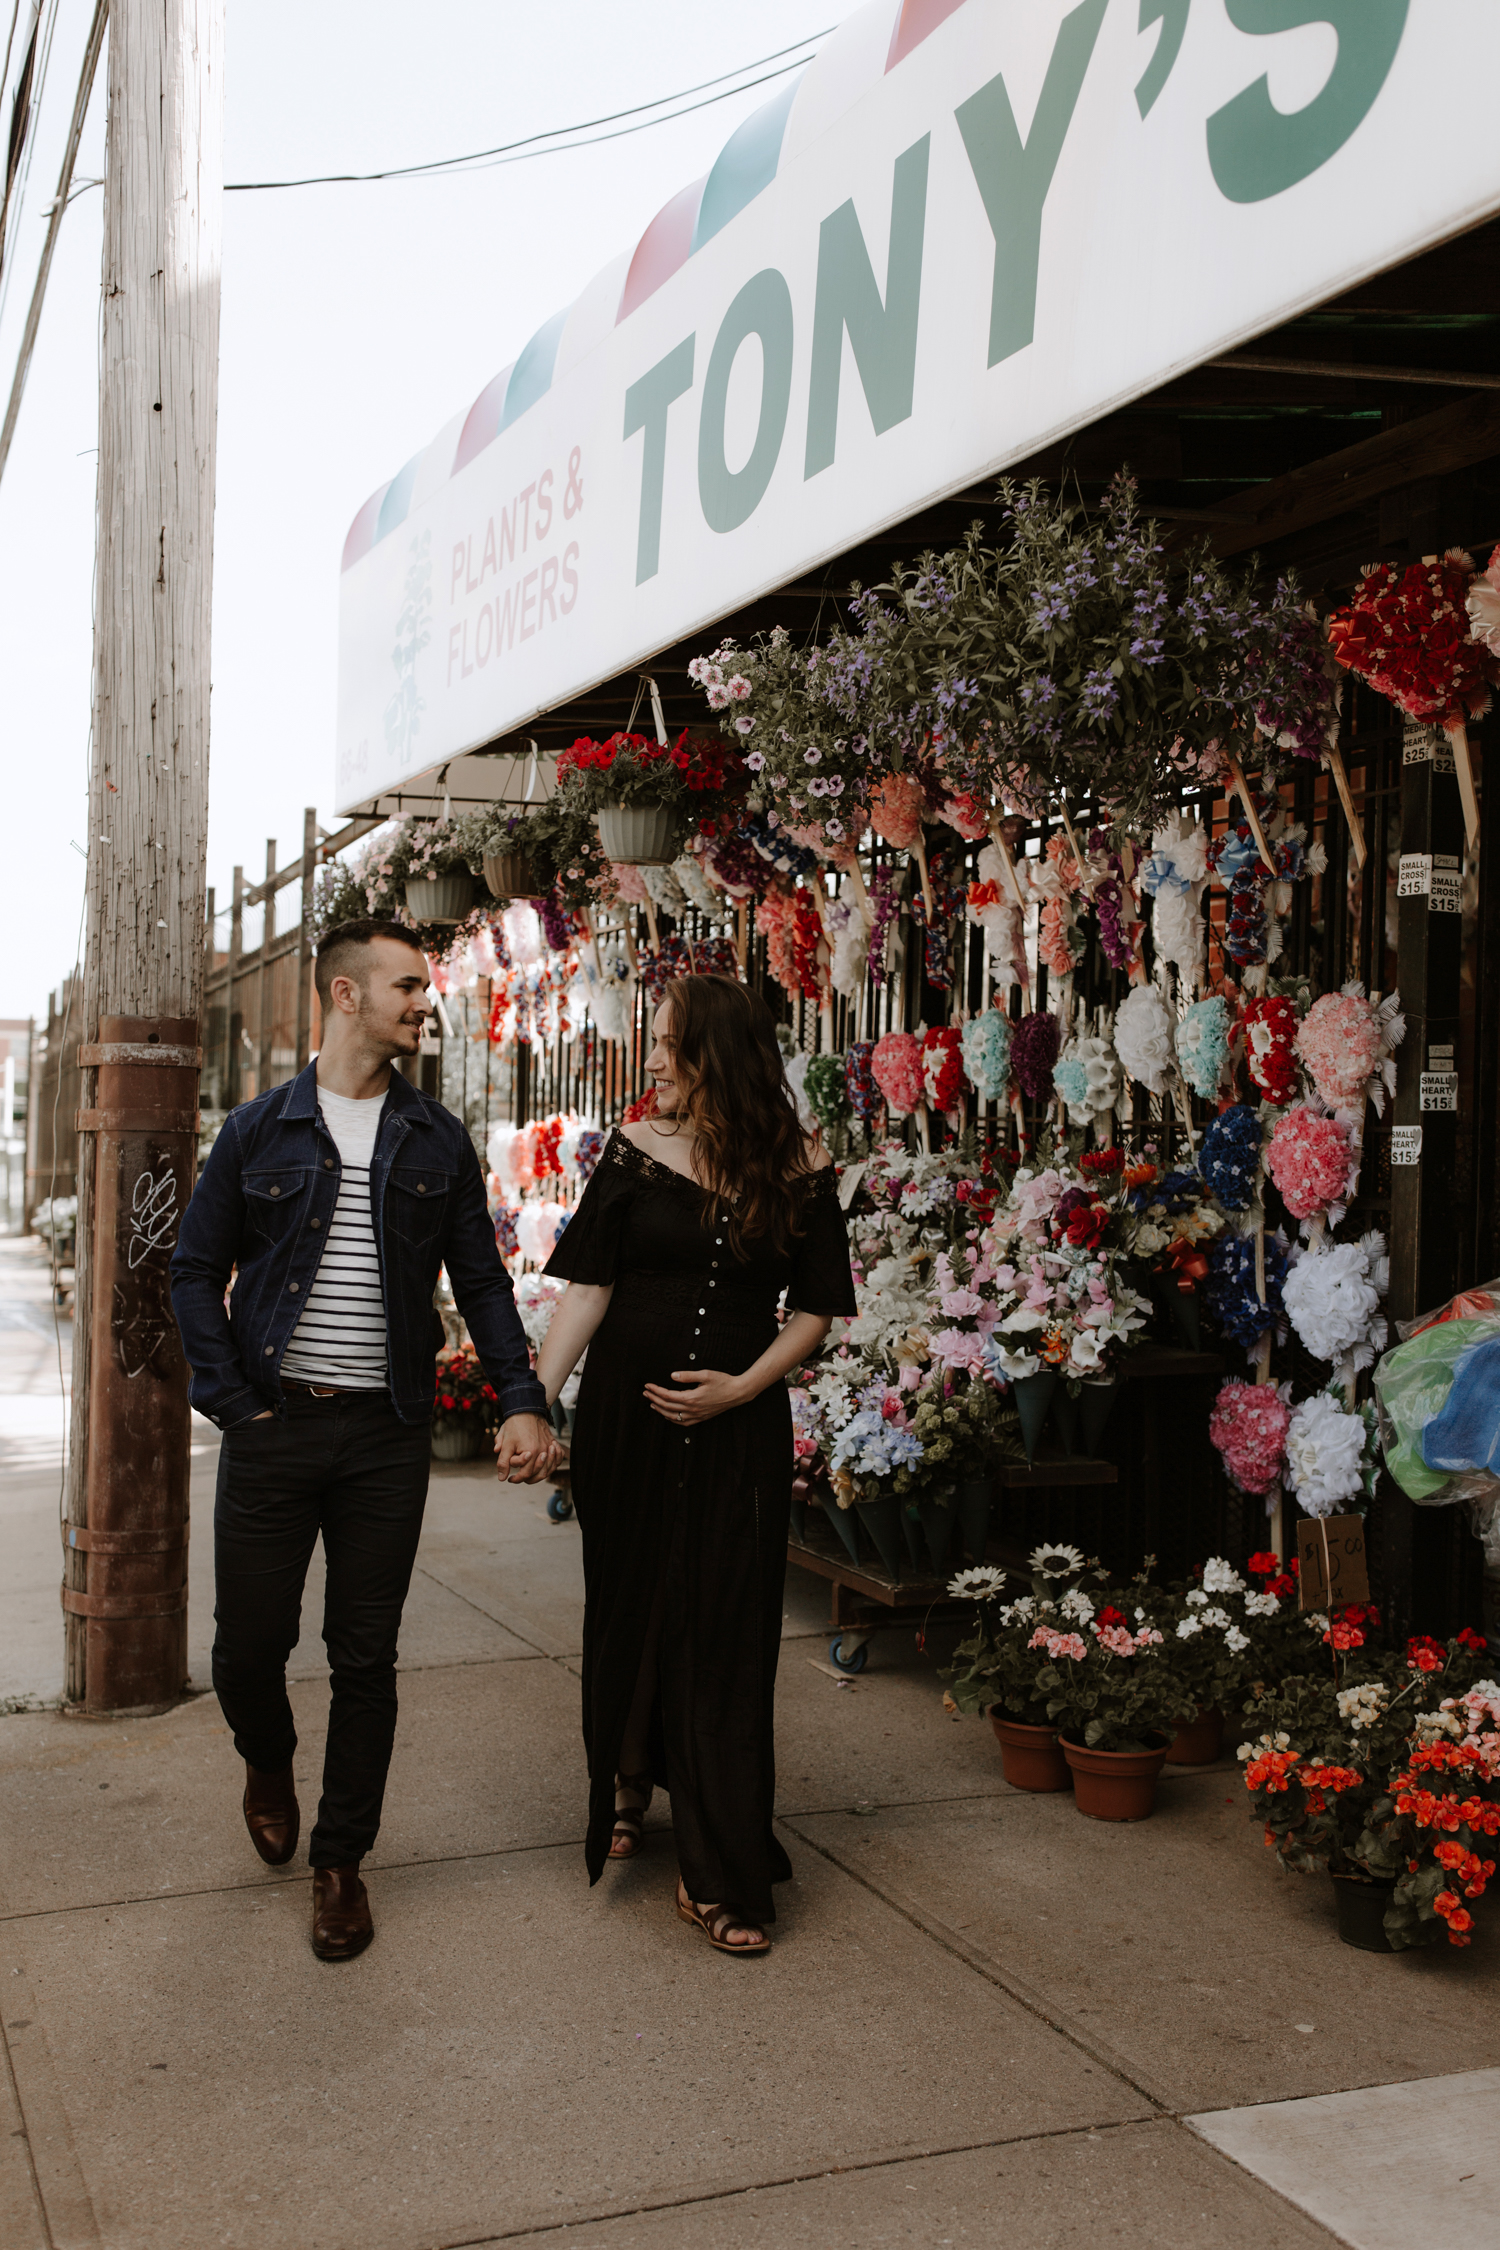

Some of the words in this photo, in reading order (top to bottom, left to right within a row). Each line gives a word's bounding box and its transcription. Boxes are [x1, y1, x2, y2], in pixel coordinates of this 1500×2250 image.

[622, 0, 1411, 588] TONY'S
[450, 468, 554, 606] PLANTS
[563, 445, 584, 521] &
[447, 540, 580, 688] FLOWERS
[1404, 723, 1433, 734] MEDIUM
[1403, 735, 1427, 748] HEART
[1405, 748, 1425, 763] $25
[1435, 747, 1453, 756] HEA
[1401, 860, 1424, 870] SMALL
[1400, 870, 1425, 880] CROSS
[1431, 877, 1459, 887] SMALL
[1399, 881, 1421, 895] $15
[1431, 887, 1459, 897] CROSS
[1430, 898, 1455, 911] $15
[1421, 1076, 1450, 1085] SMALL
[1421, 1086, 1451, 1095] HEART
[1423, 1097, 1447, 1109] $15
[1391, 1130, 1415, 1139] SMALL
[1391, 1140, 1415, 1148] HEART
[1392, 1150, 1412, 1163] $15
